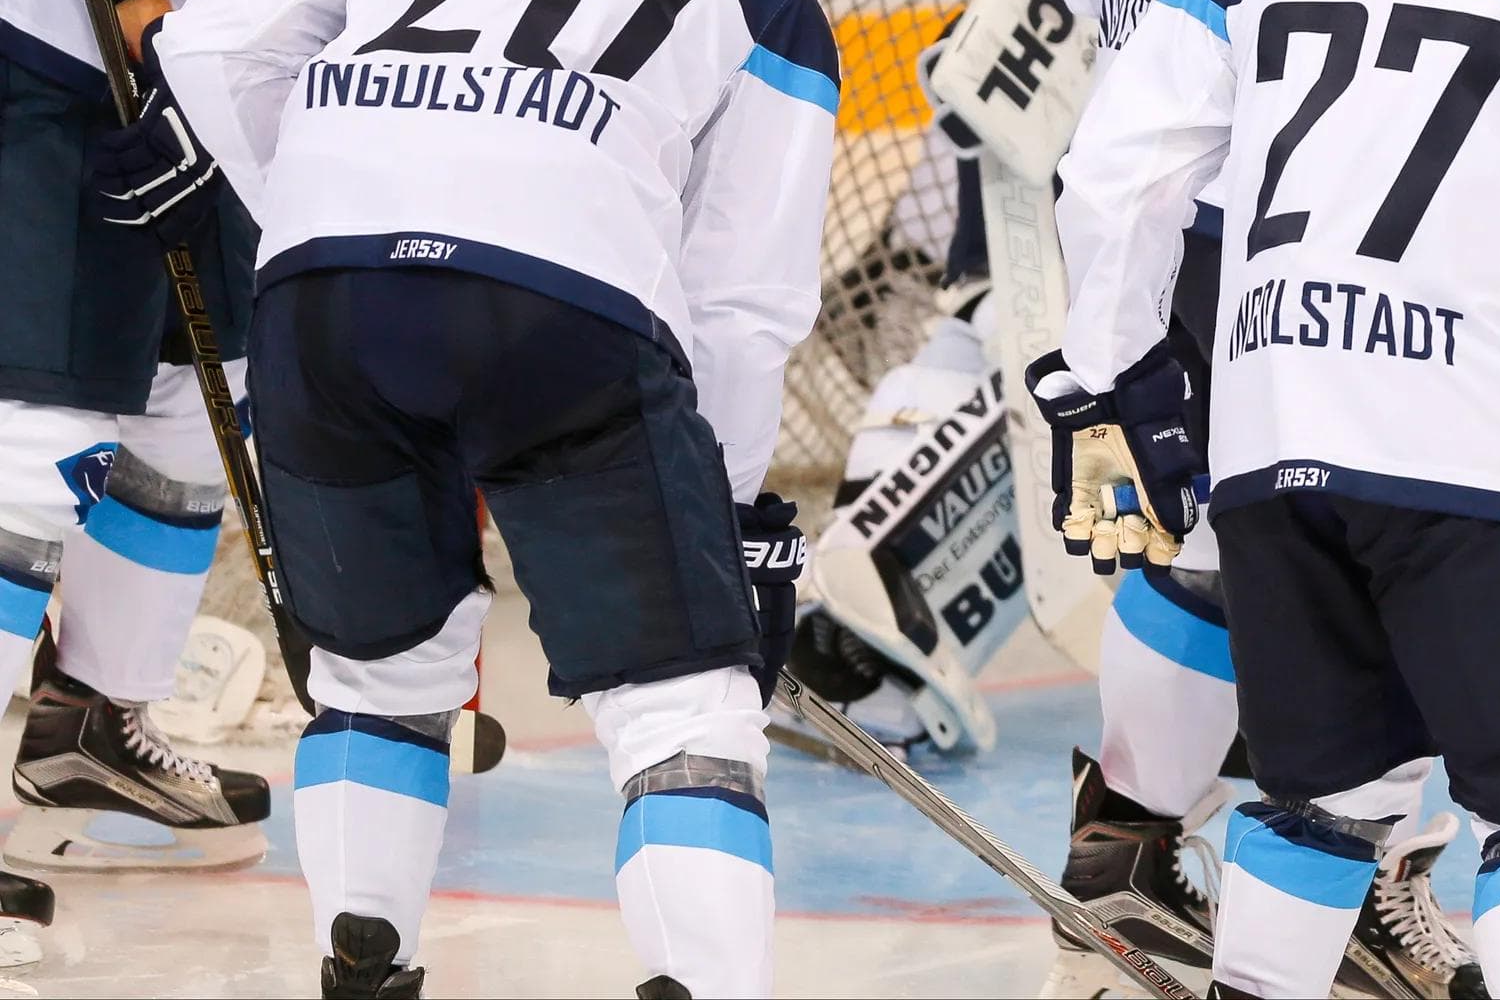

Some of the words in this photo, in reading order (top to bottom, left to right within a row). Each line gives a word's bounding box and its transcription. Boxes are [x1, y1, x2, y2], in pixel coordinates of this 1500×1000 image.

[304, 60, 622, 147] INGOLSTADT
[1228, 278, 1465, 367] INGOLSTADT
[1056, 400, 1098, 419] BAUER
[919, 442, 1012, 542] VAUG
[915, 559, 953, 593] Der
[1150, 911, 1194, 940] BAUER
[1123, 948, 1199, 1000] BAU
